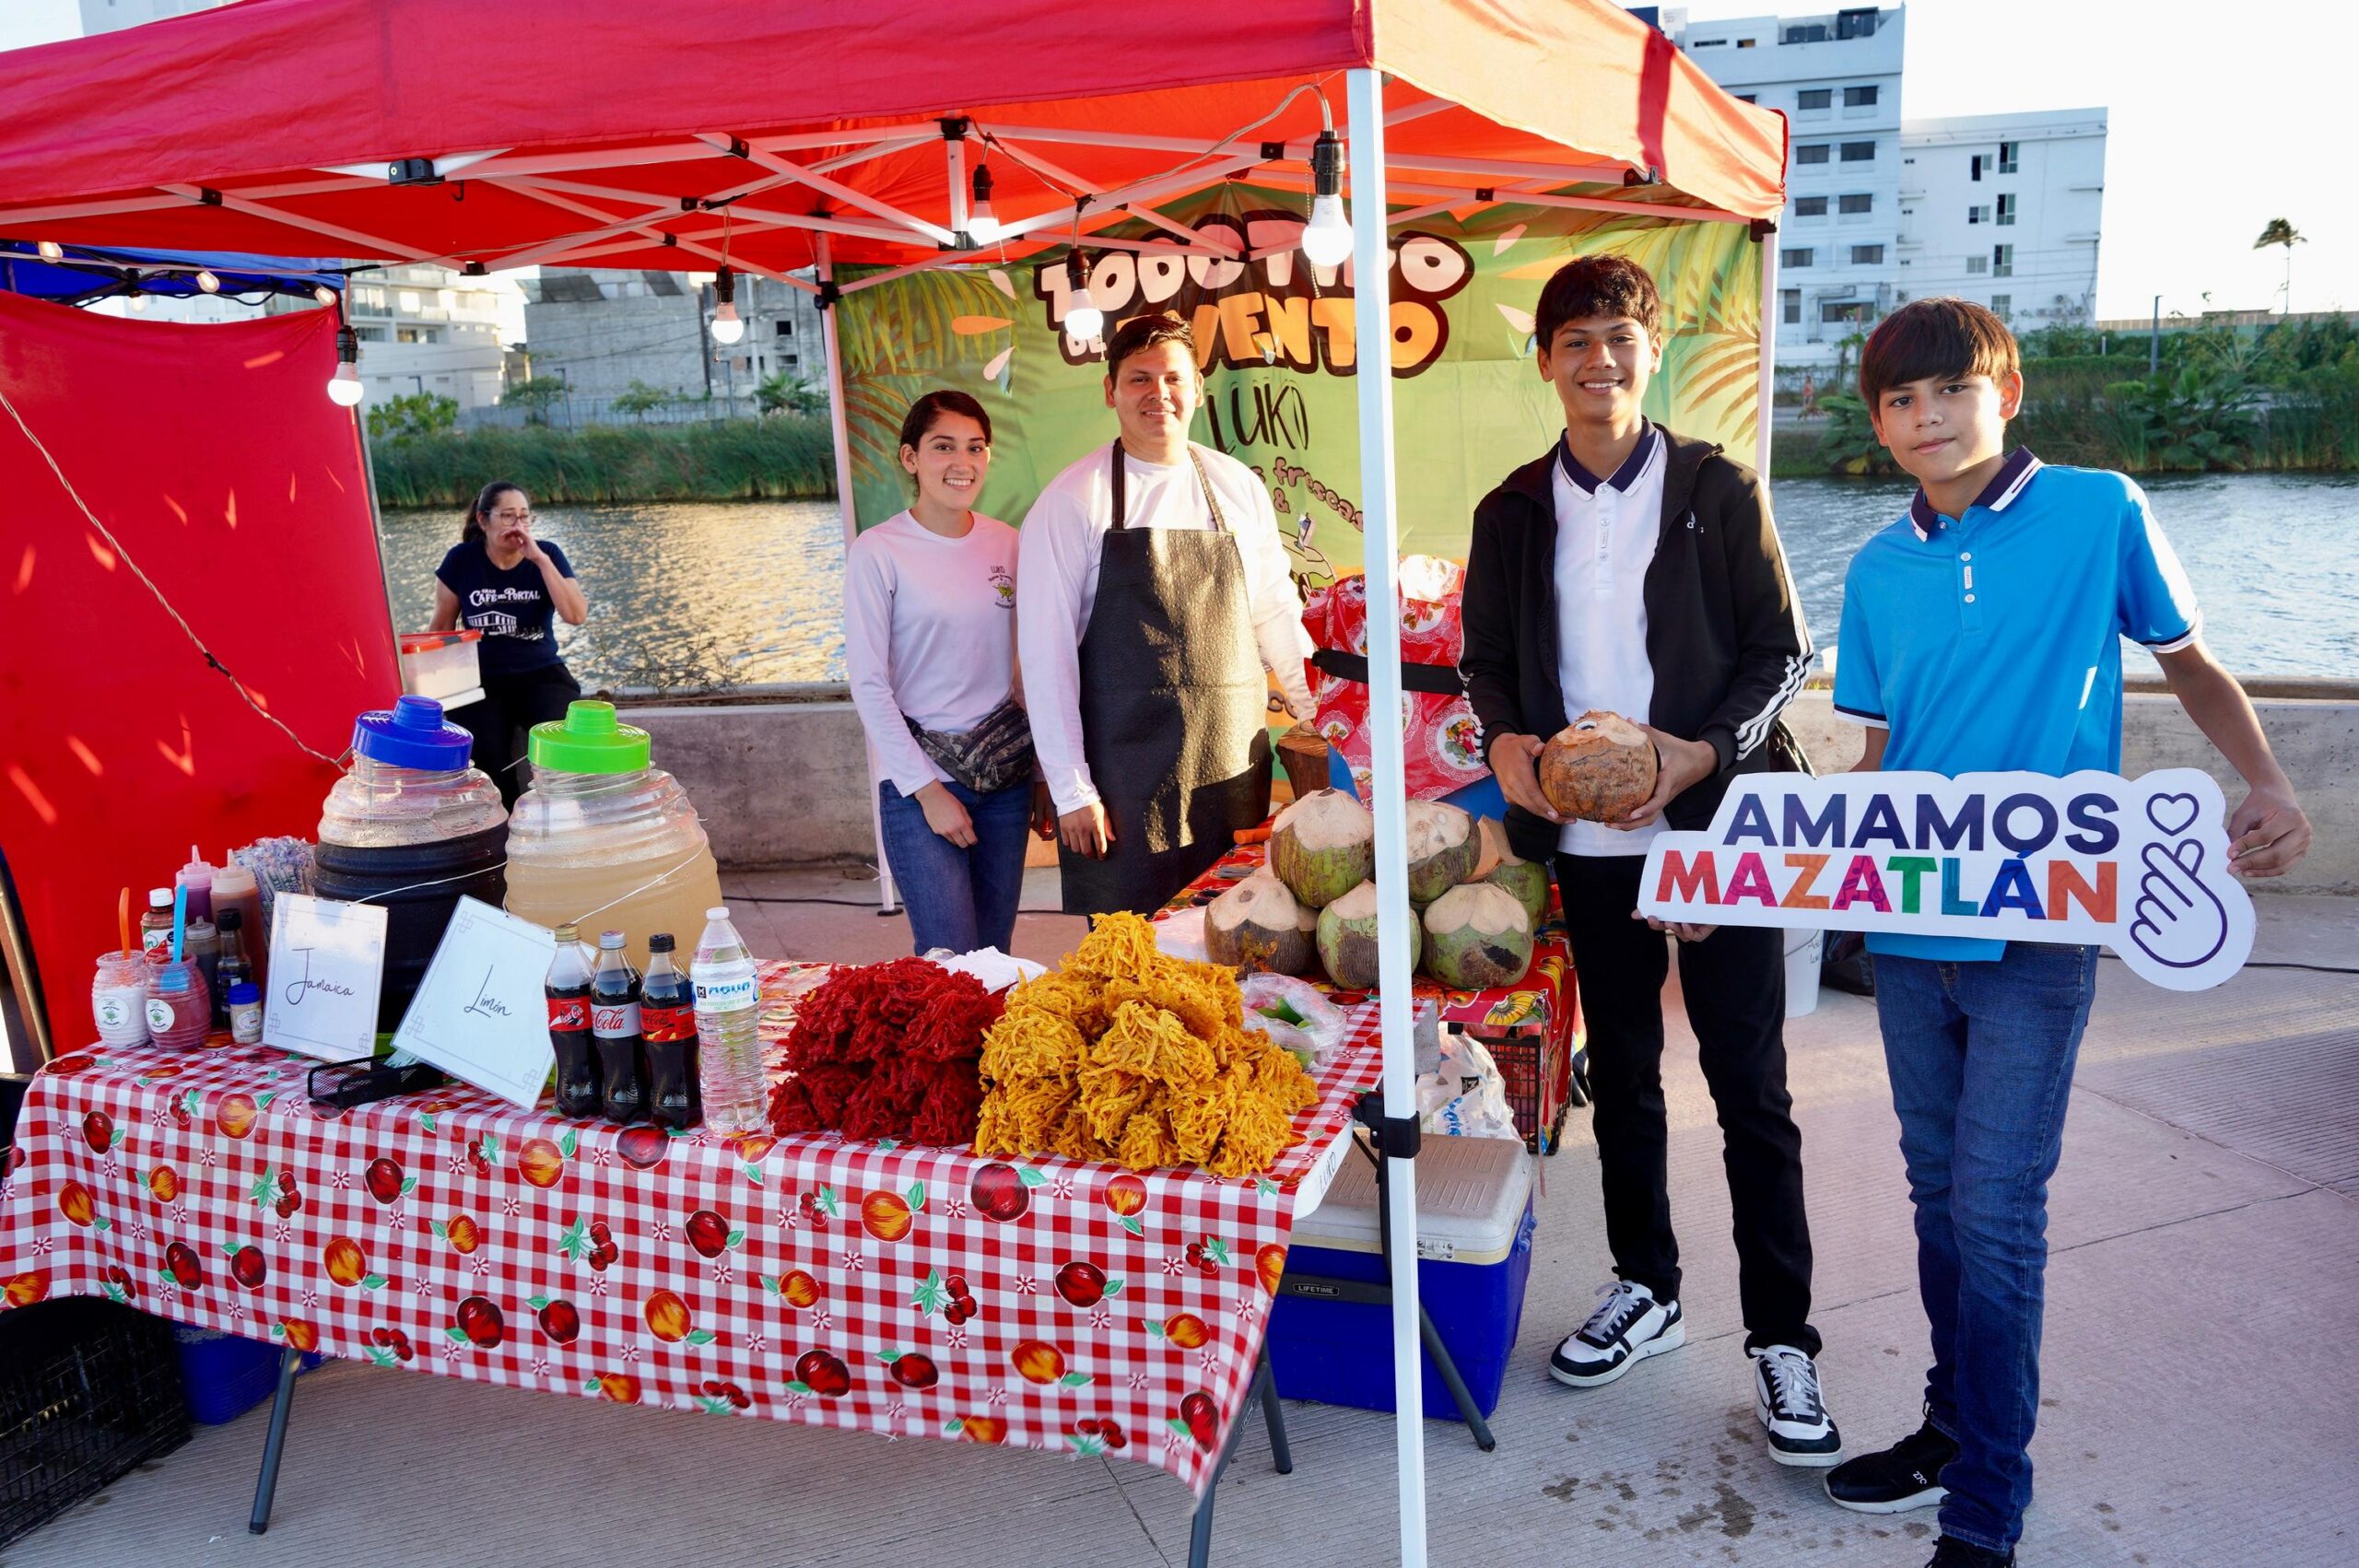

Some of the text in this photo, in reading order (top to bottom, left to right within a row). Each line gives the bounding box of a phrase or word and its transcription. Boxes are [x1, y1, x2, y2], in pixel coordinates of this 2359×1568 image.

[503, 587, 541, 601] PORTAL
[1722, 792, 2119, 853] AMAMOS
[1655, 848, 2117, 923] MAZATLÁN
[286, 947, 355, 1005] Jamaica
[464, 964, 512, 1018] Limón
[1297, 1284, 1334, 1293] LIFETIME
